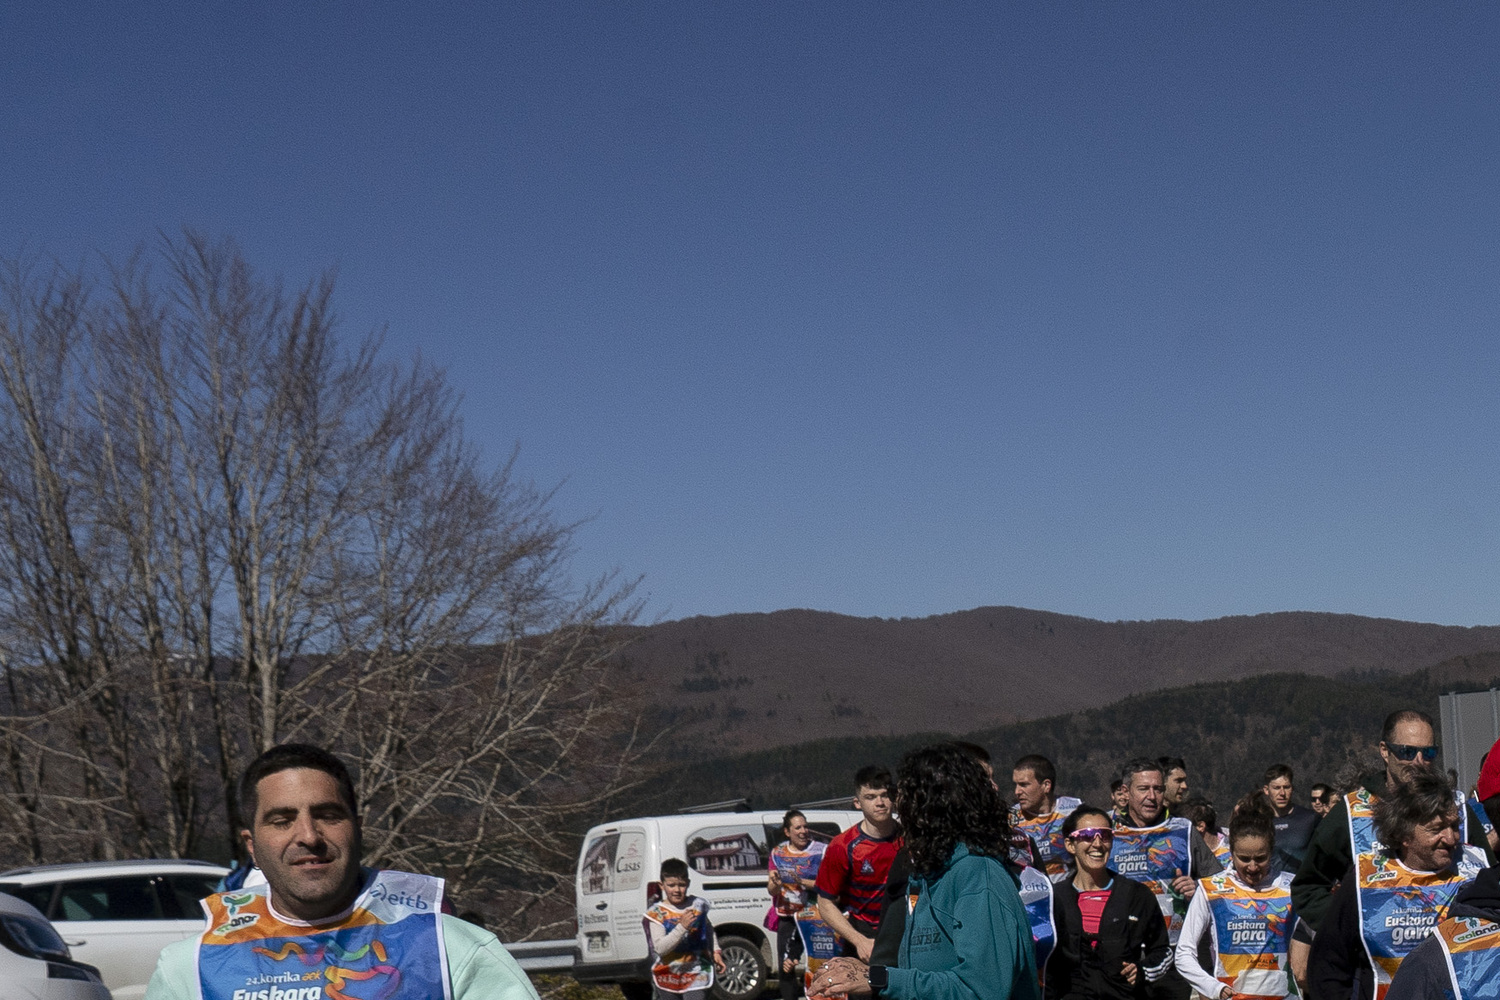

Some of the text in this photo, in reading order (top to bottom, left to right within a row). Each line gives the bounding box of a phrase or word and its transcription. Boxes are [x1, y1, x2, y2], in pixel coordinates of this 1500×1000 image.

[1114, 854, 1147, 863] Euskara
[1118, 861, 1148, 875] gara
[390, 891, 428, 910] eitb
[1227, 920, 1266, 931] Euskara
[1385, 915, 1434, 927] Euskara
[1232, 930, 1266, 945] gara
[245, 971, 300, 986] 24.korrika
